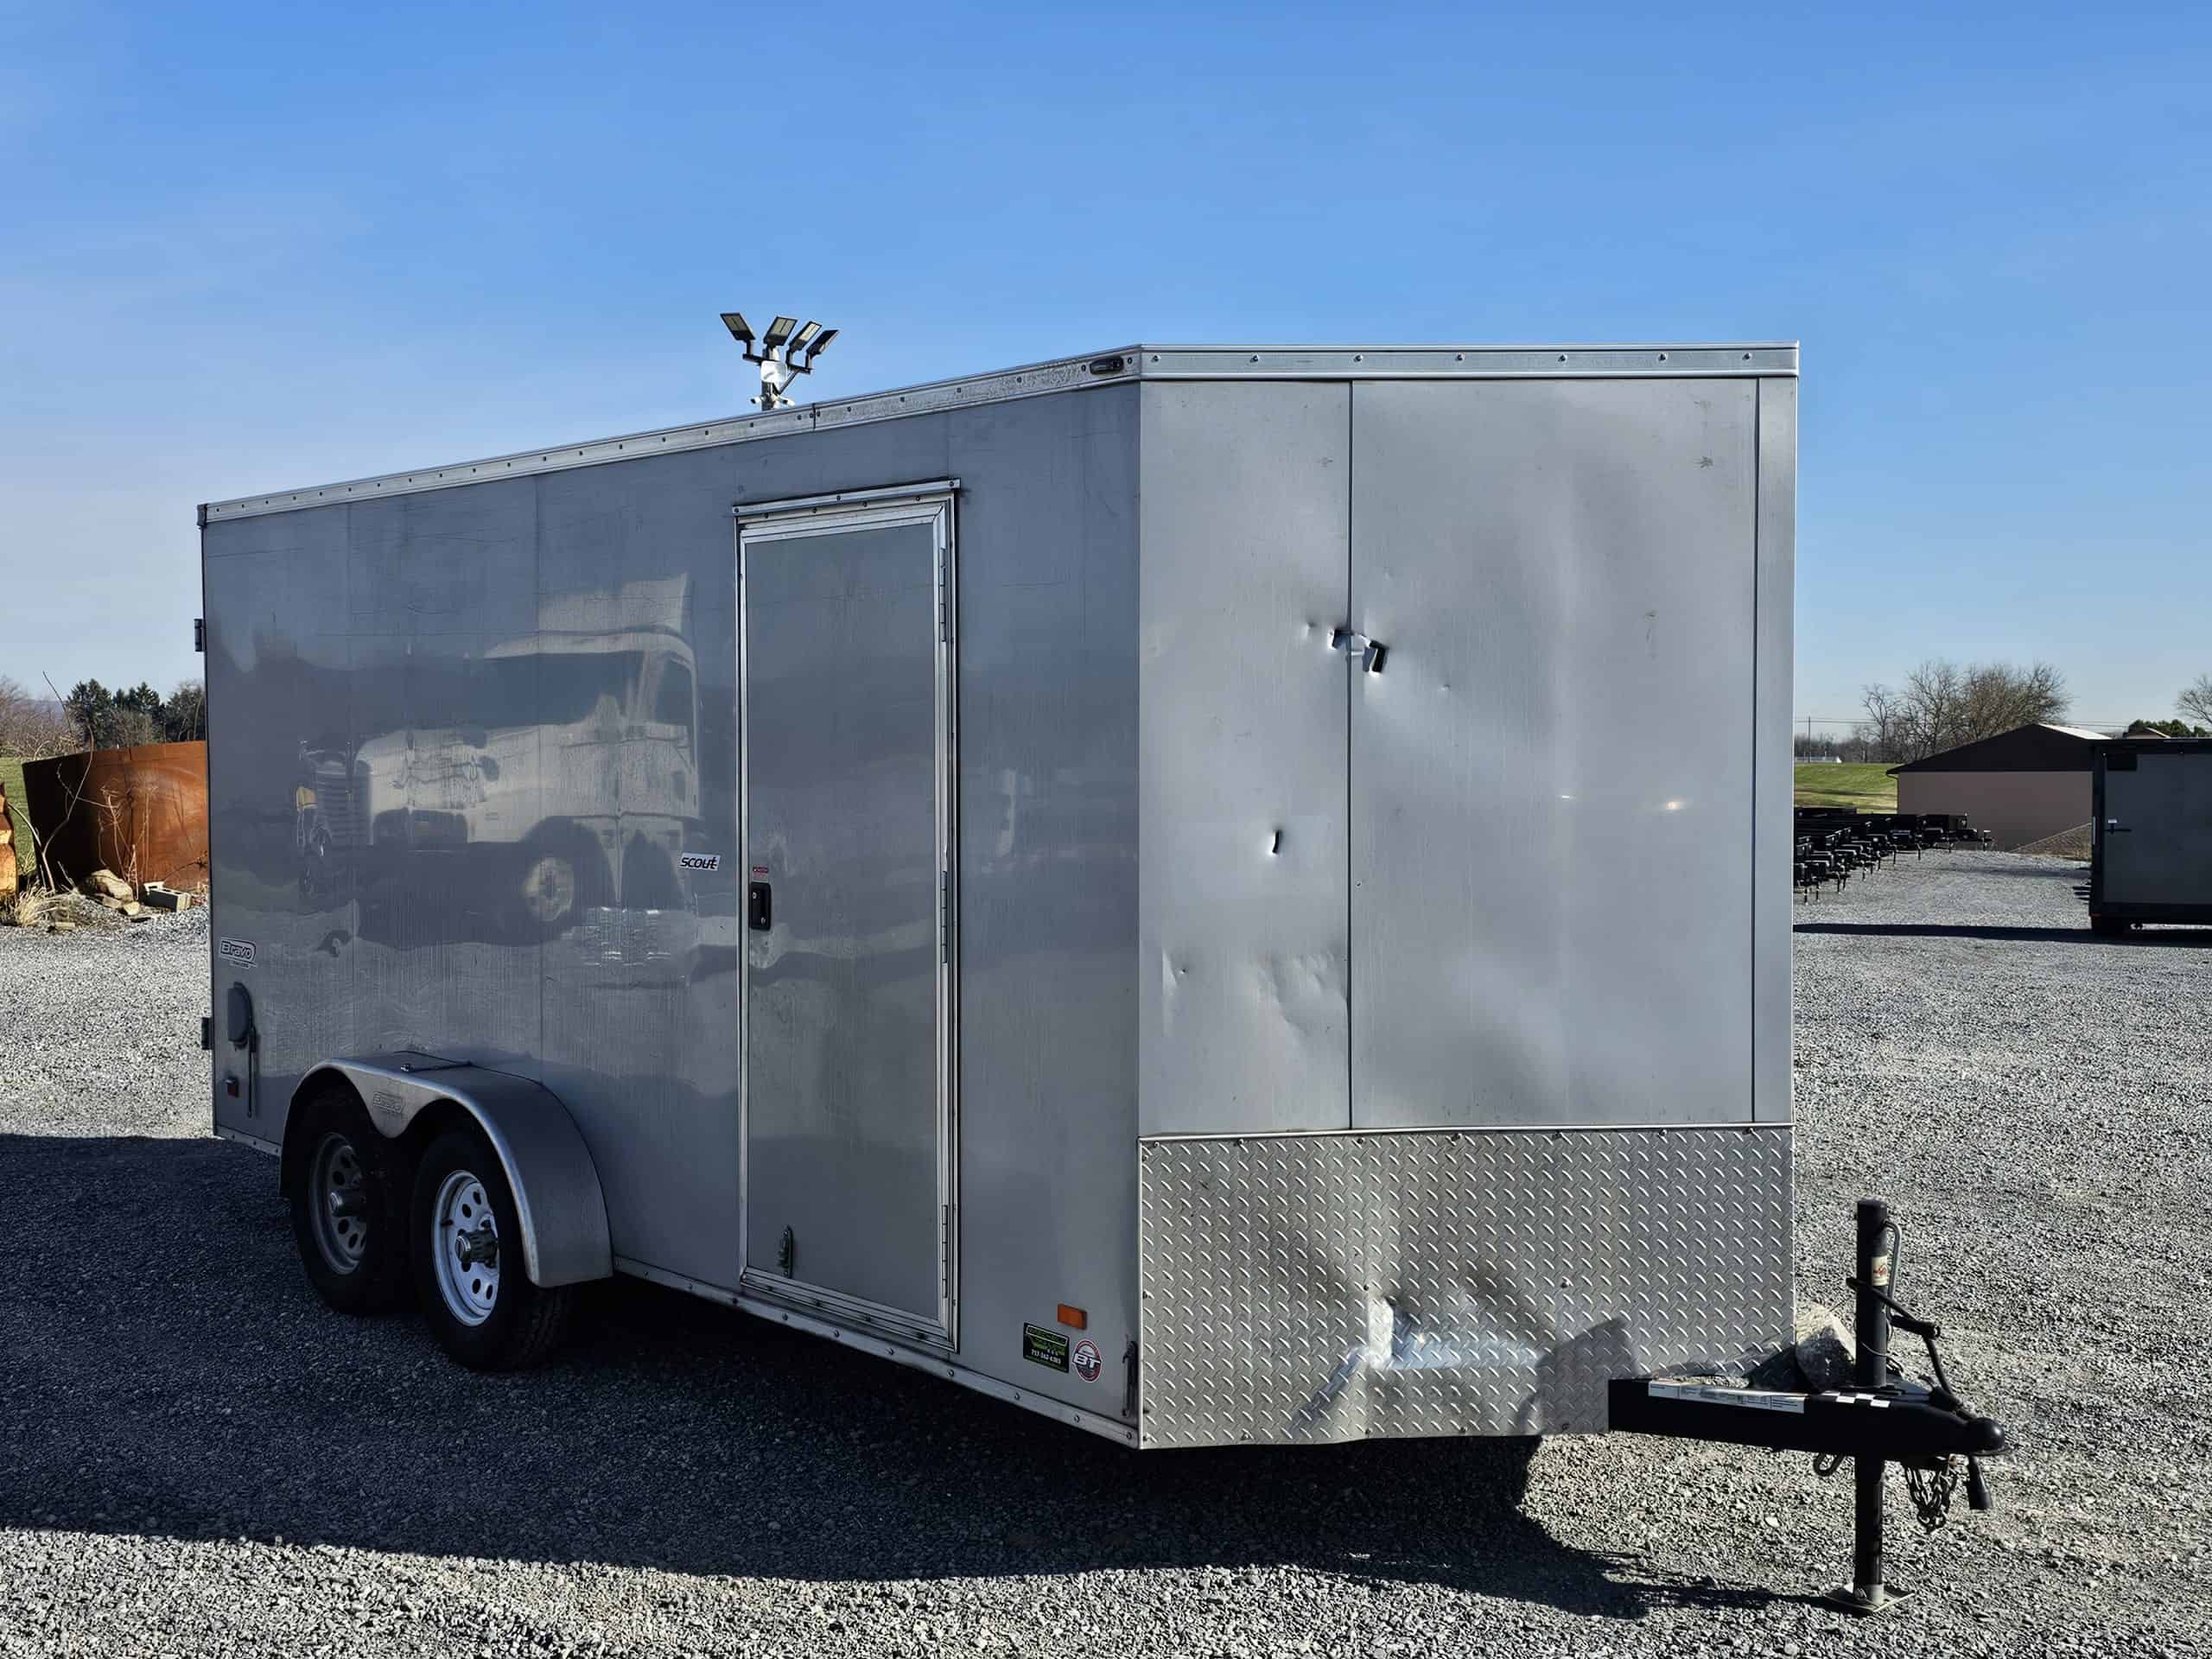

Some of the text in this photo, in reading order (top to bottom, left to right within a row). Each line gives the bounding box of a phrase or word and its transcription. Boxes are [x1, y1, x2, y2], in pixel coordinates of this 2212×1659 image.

[681, 857, 718, 869] scout
[221, 942, 251, 958] Bravo
[1073, 1353, 1101, 1369] BT
